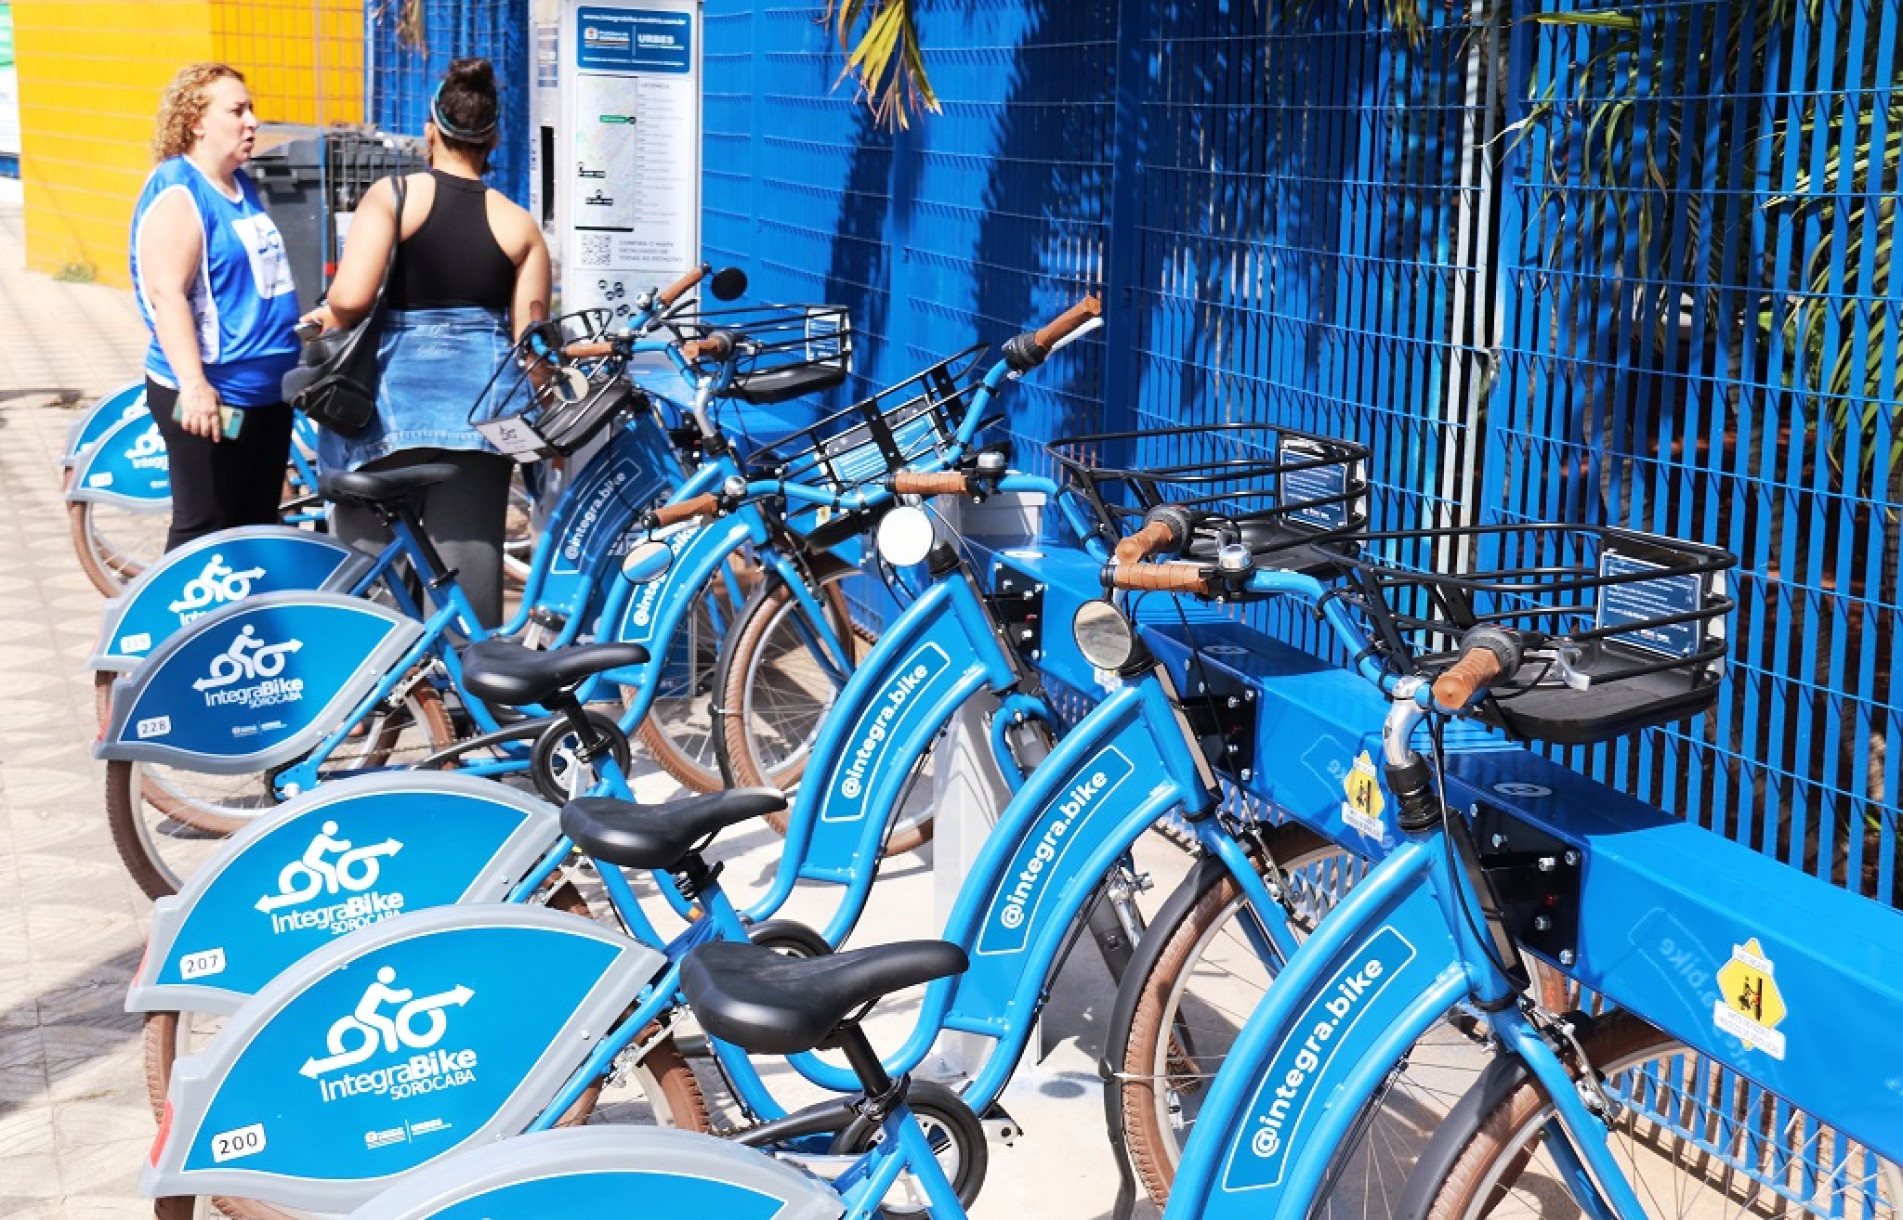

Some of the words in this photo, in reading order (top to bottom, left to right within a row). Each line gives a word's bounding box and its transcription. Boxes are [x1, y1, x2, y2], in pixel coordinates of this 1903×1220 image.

[205, 678, 303, 707] IntegraBike
[841, 665, 928, 799] @integra.bike
[1001, 772, 1108, 929] @integra.bike
[272, 891, 404, 934] IntegraBike
[186, 955, 218, 973] 207
[319, 1048, 478, 1102] IntegraBike
[1252, 959, 1383, 1158] @integra.bike
[389, 1069, 477, 1100] SOROCABA
[219, 1132, 258, 1155] 200
